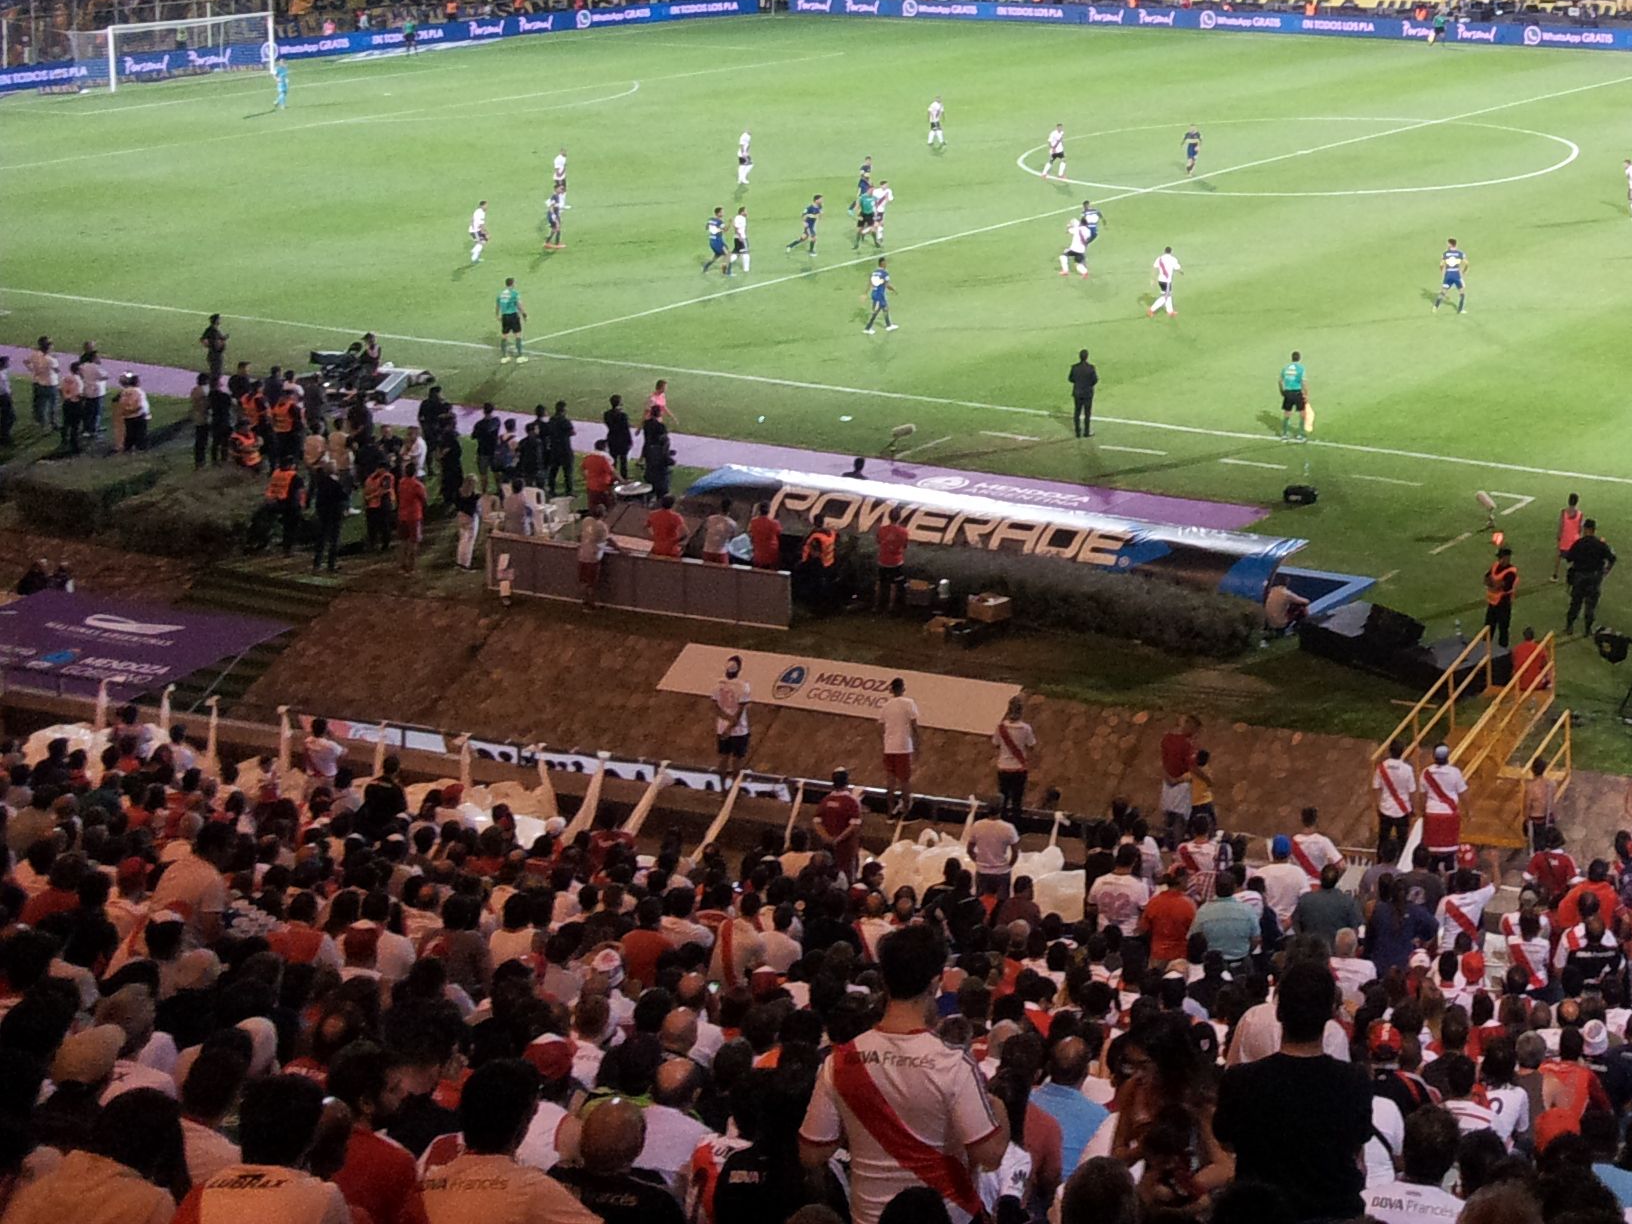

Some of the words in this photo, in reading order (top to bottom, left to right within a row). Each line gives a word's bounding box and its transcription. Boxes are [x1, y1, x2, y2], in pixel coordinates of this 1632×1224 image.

[592, 12, 624, 22] WhatsApp
[624, 8, 651, 20] GRATIS
[918, 4, 951, 16] WhatsApp
[951, 4, 978, 15] GRATIS
[1217, 16, 1252, 28] WhatsApp
[1252, 17, 1281, 29] GRATIS
[1542, 31, 1581, 44] WhatsApp
[1582, 32, 1613, 44] GRATIS
[278, 43, 318, 56] WhatsApp
[318, 38, 349, 51] GRATIS
[770, 485, 1129, 567] POWERADE
[883, 1051, 936, 1069] Francés
